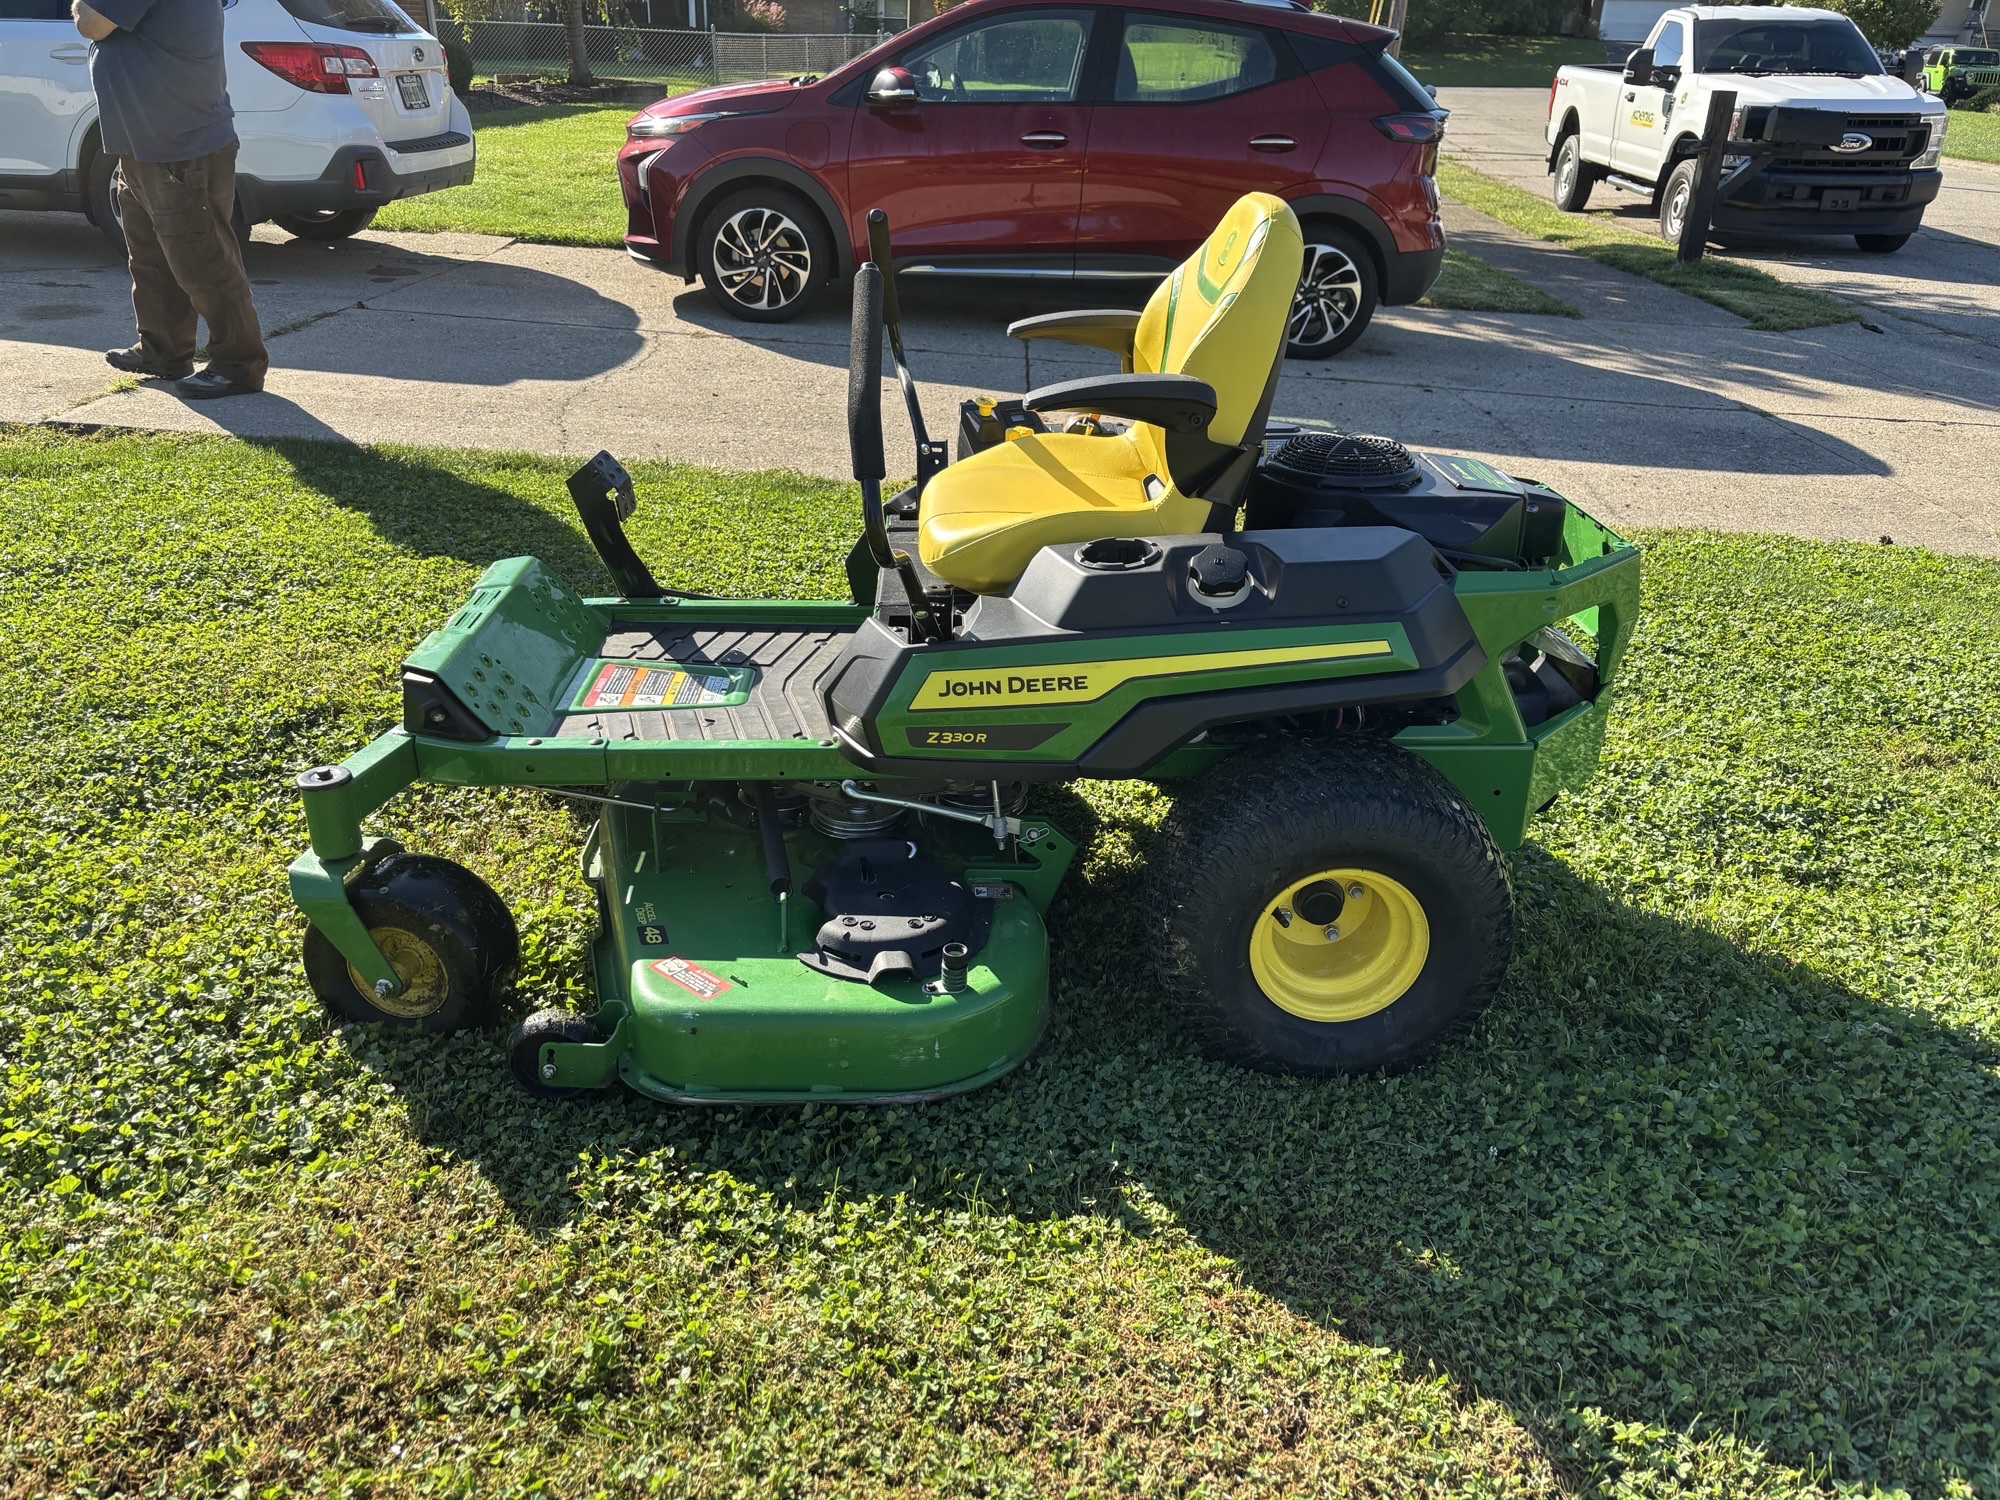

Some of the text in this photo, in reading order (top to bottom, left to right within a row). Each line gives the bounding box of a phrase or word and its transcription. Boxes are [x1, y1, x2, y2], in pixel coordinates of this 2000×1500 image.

[1840, 138, 1861, 148] Ford
[938, 675, 1088, 698] JOHN DEERE
[926, 731, 987, 745] Z330R
[634, 907, 647, 925] DEEP
[643, 901, 656, 922] ACCEL
[644, 927, 662, 944] 48
